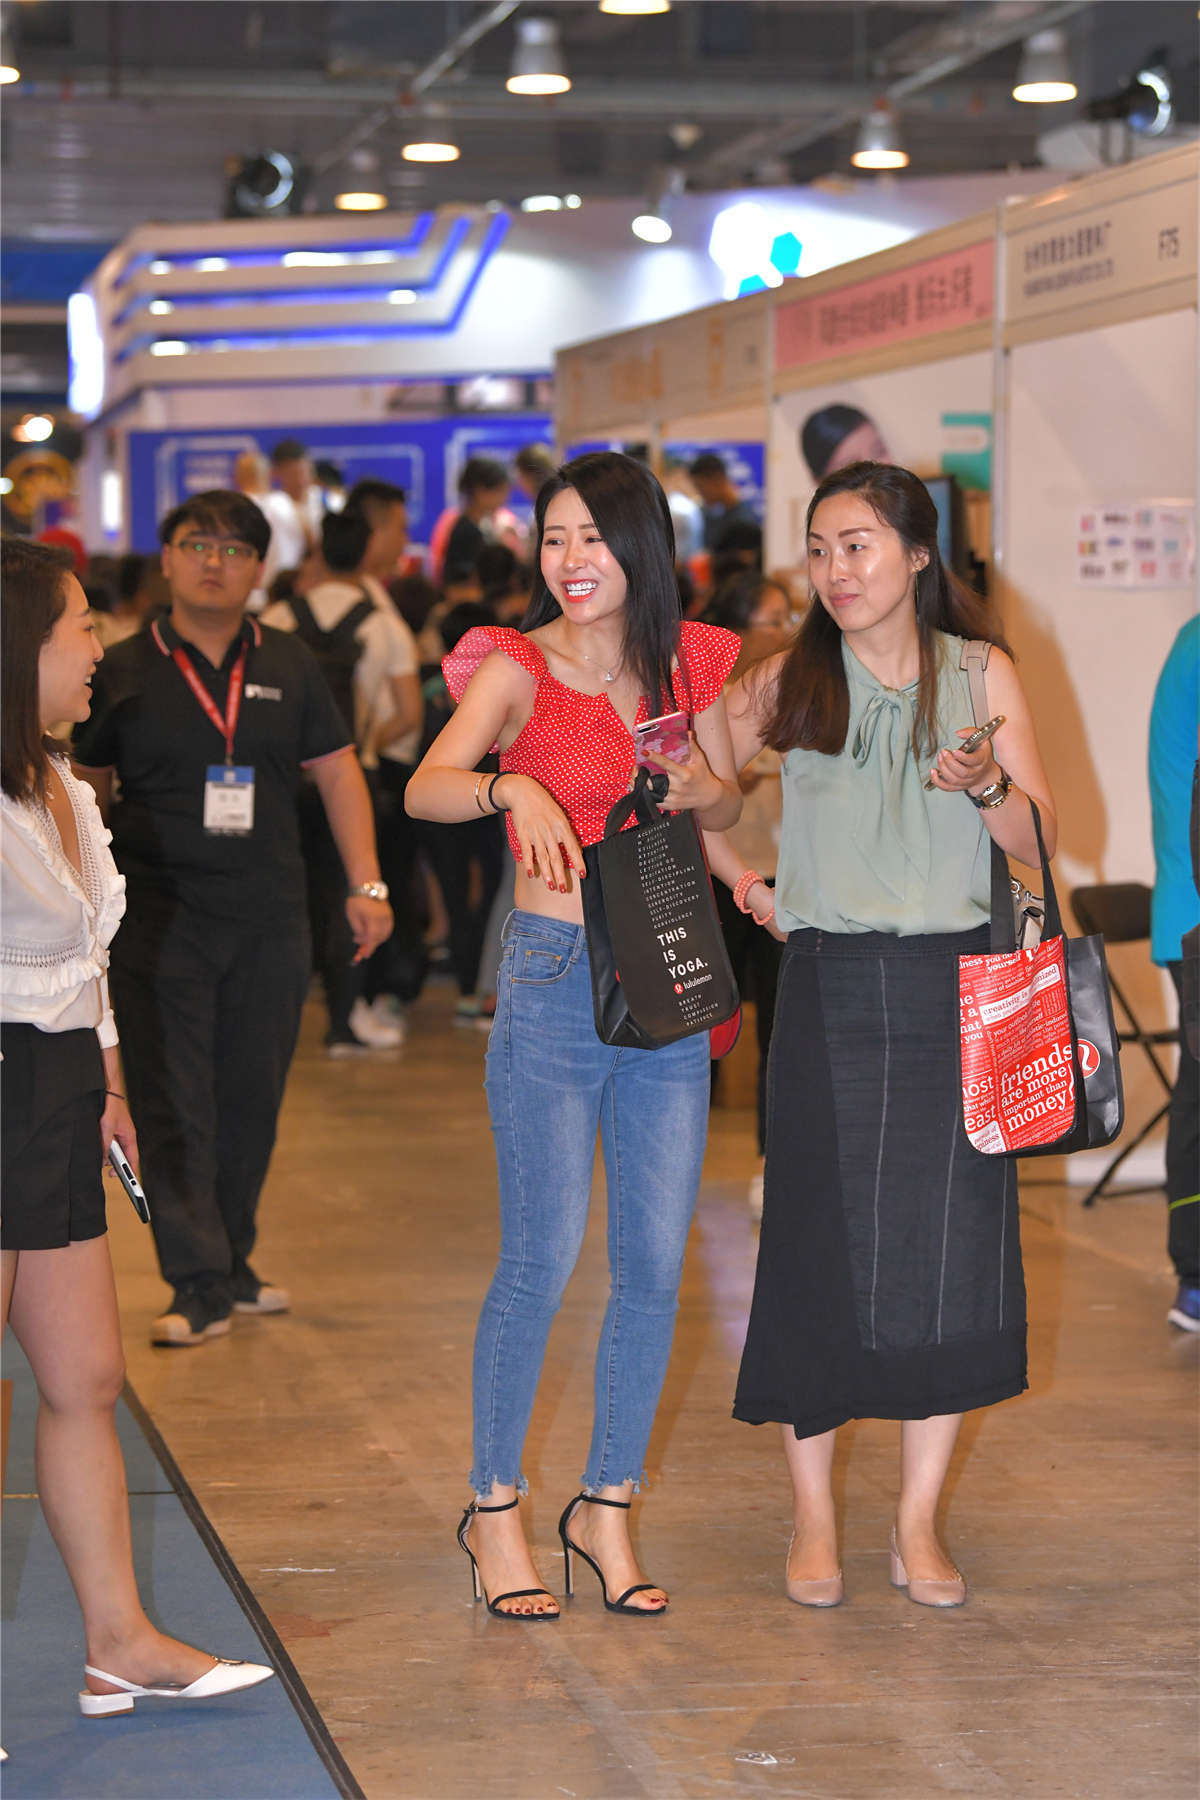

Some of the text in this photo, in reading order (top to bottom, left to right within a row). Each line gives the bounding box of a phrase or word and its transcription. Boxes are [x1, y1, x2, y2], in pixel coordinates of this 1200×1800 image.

[1158, 226, 1180, 260] F75
[656, 927, 687, 946] THIS
[663, 949, 676, 964] IS
[668, 957, 708, 979] YOGA.
[682, 974, 713, 990] lululemon
[967, 1007, 978, 1018] a
[983, 996, 1020, 1017] creativity
[964, 1031, 984, 1045] you
[1000, 1042, 1073, 1096] friends
[1001, 1066, 1068, 1108] are more
[1003, 1079, 1067, 1117] important than
[964, 1104, 997, 1132] east
[1006, 1089, 1067, 1132] money
